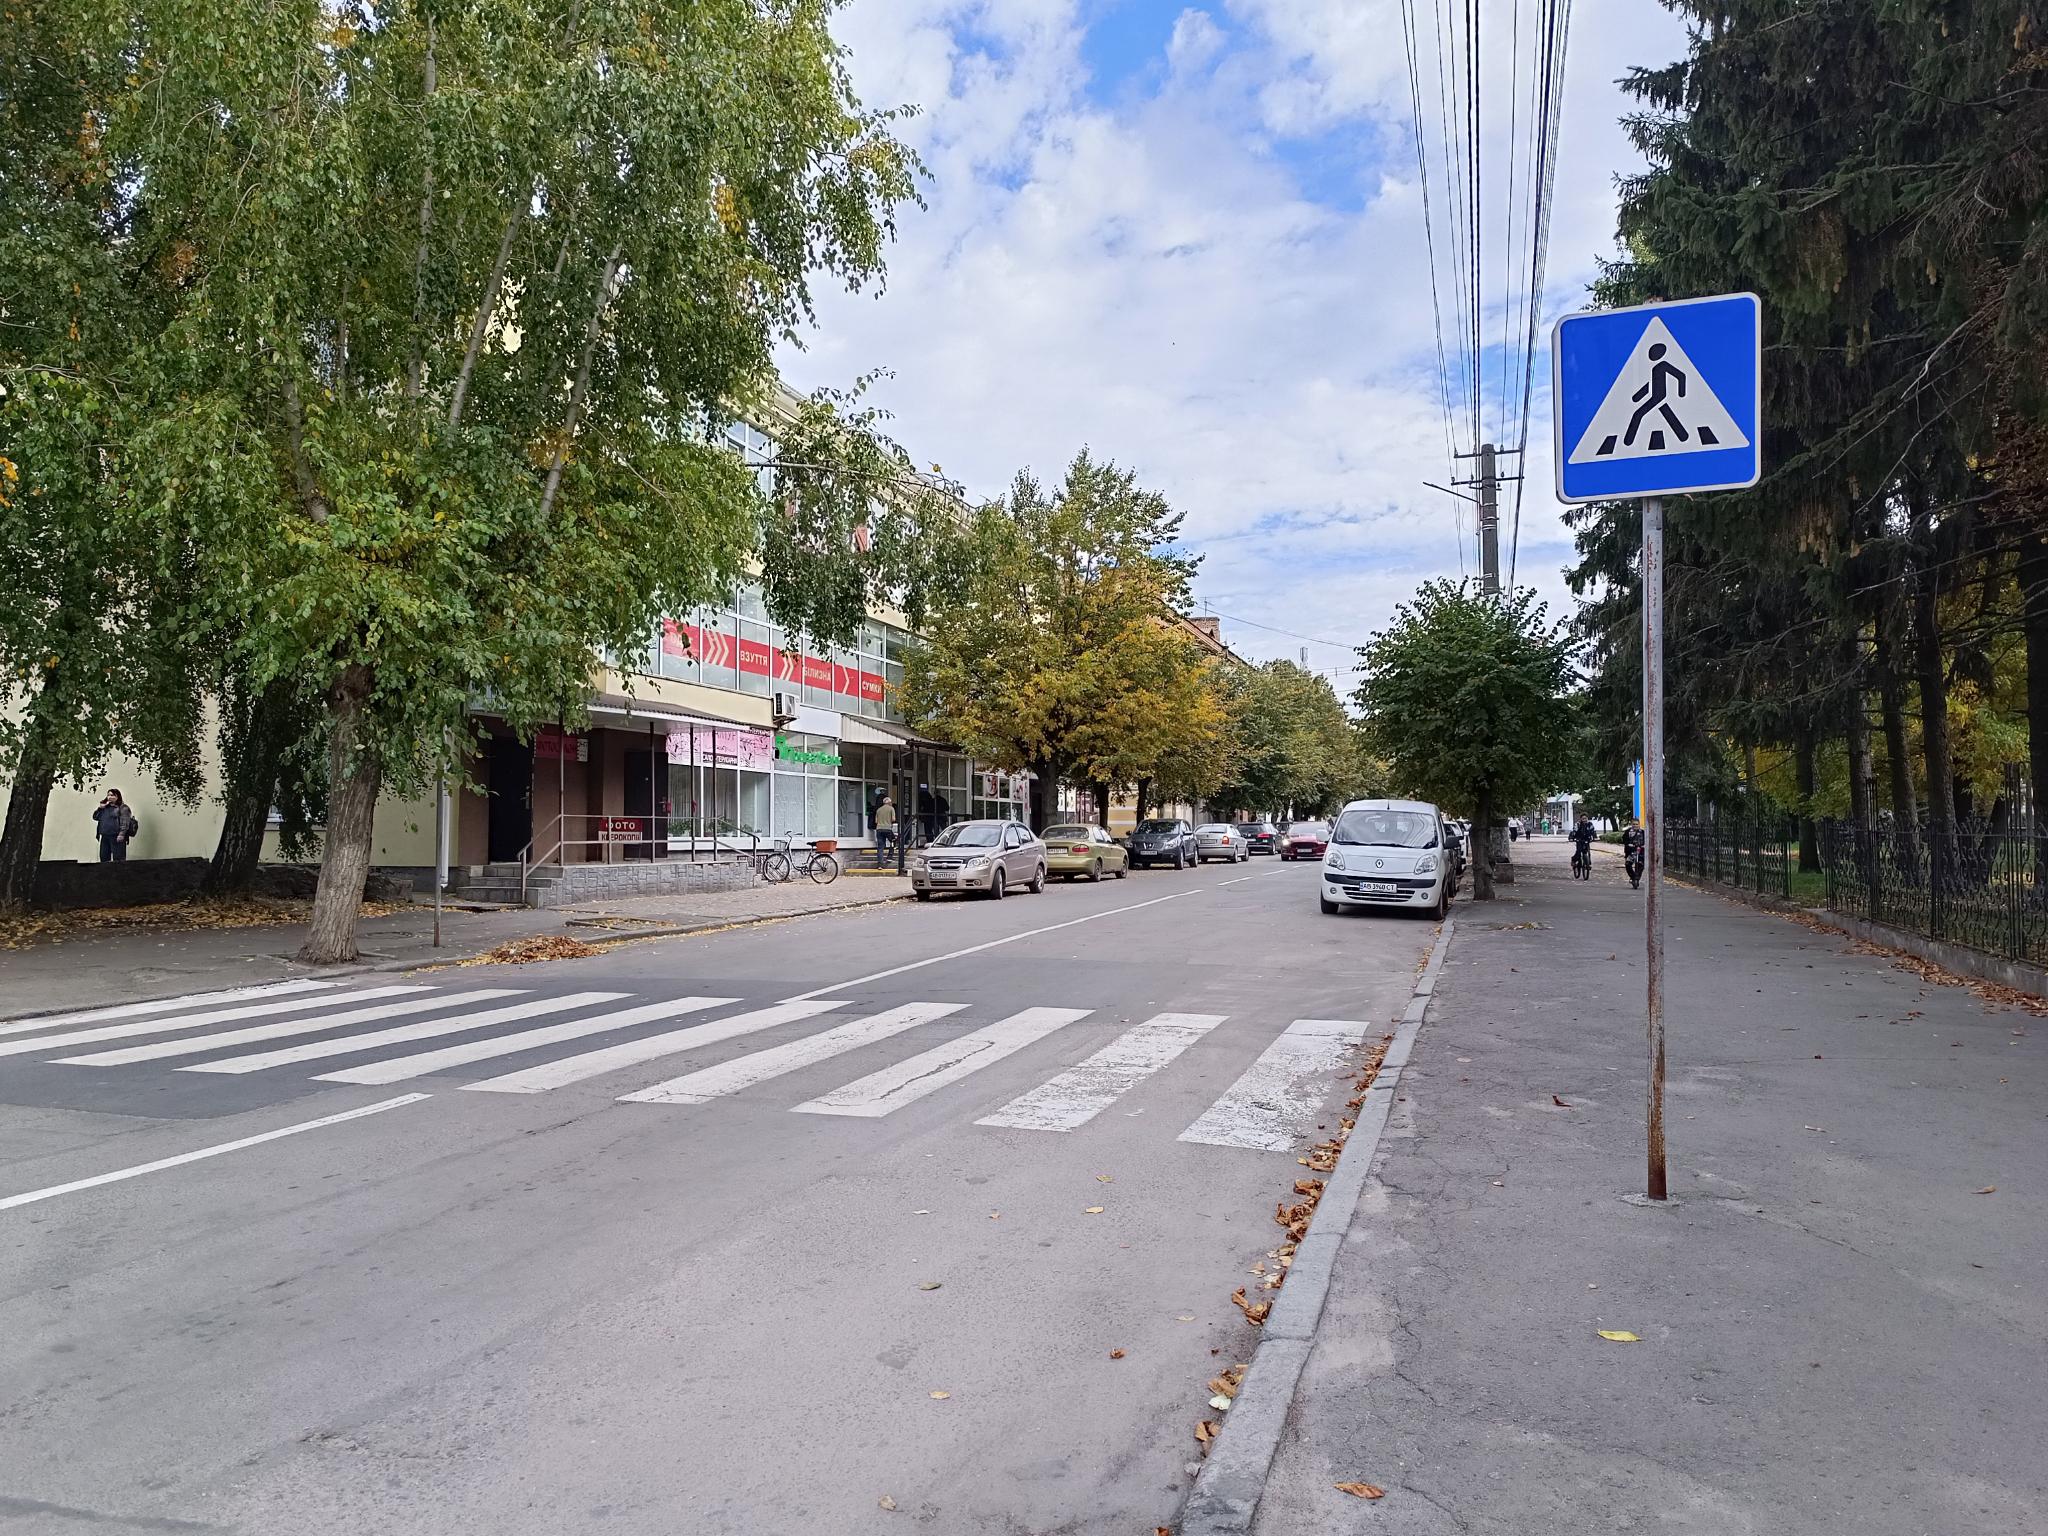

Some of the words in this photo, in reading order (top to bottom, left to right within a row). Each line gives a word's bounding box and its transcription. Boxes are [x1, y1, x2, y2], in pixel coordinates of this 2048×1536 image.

[740, 650, 768, 667] ВЗУТТЯ
[803, 667, 831, 683] БІЛИЗНА
[861, 680, 882, 693] СУМКИ
[605, 821, 636, 830] ФОТО
